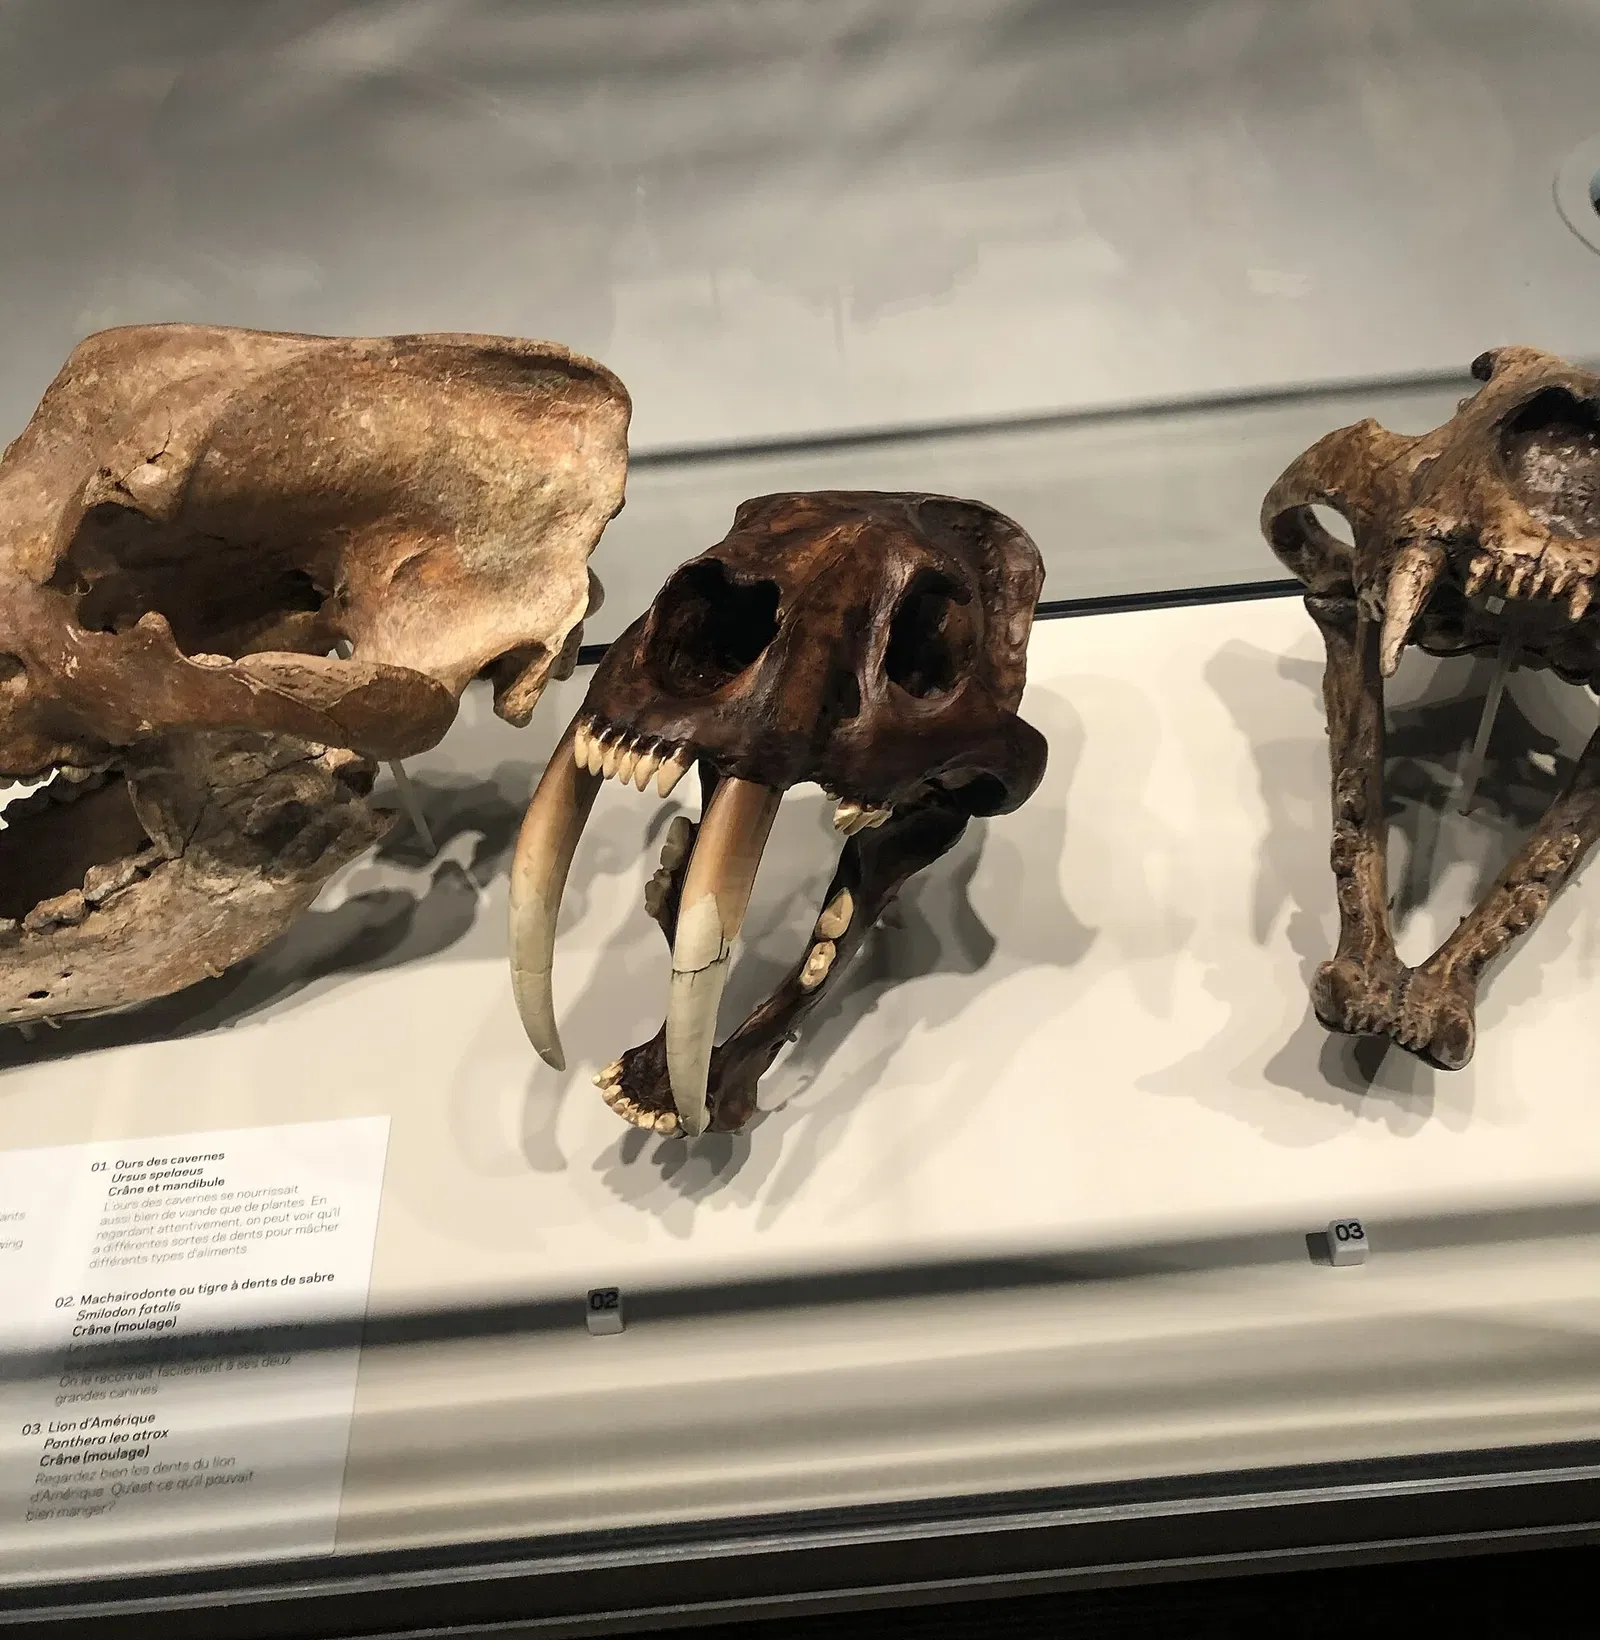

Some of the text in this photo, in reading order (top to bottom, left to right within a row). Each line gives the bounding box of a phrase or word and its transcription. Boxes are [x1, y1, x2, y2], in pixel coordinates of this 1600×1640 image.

[115, 1159, 144, 1170] Ours
[146, 1157, 168, 1167] des
[170, 1152, 225, 1163] cavernes
[108, 1176, 225, 1197] Crâne et mandibule
[111, 1167, 204, 1184] Ursus spelaeus
[141, 1198, 163, 1208] des
[165, 1192, 218, 1206] cavernes
[220, 1192, 235, 1200] se
[236, 1184, 300, 1199] nourrissait
[99, 1214, 132, 1226] aussi
[134, 1211, 159, 1223] bien
[161, 1209, 177, 1220] de
[179, 1206, 218, 1217] viande
[219, 1204, 242, 1216] que
[244, 1201, 259, 1212] de
[310, 1194, 328, 1206] En
[96, 1206, 341, 1242] regardant attentivement, on peut voir qu'il
[1335, 1222, 1364, 1242] 03
[102, 1238, 170, 1254] différentes
[171, 1233, 209, 1249] sortes
[211, 1231, 228, 1243] de
[229, 1229, 263, 1241] dents
[265, 1226, 295, 1240] pour
[295, 1222, 340, 1235] mâcher
[88, 1255, 149, 1270] différents
[151, 1252, 185, 1265] types
[79, 1287, 177, 1306] Machairodonte
[179, 1286, 195, 1296] ou
[198, 1281, 229, 1296] tigre
[230, 1279, 239, 1291] à
[241, 1278, 278, 1290] dents
[280, 1274, 296, 1286] de
[298, 1271, 335, 1285] sabre
[75, 1300, 182, 1322] Smilodon fatalis
[591, 1291, 619, 1310] 02
[72, 1324, 111, 1338] Crâne
[113, 1315, 178, 1335] (moulage)
[54, 1390, 107, 1407] grandes
[48, 1420, 77, 1434] Lion
[78, 1412, 156, 1431] d'Amérique
[42, 1428, 169, 1450] Panthera leo atrox
[39, 1443, 151, 1468] Crâne (moulage)
[99, 1466, 128, 1480] bien
[152, 1460, 191, 1475] dents
[192, 1457, 210, 1471] du
[204, 1469, 256, 1489] pouvait
